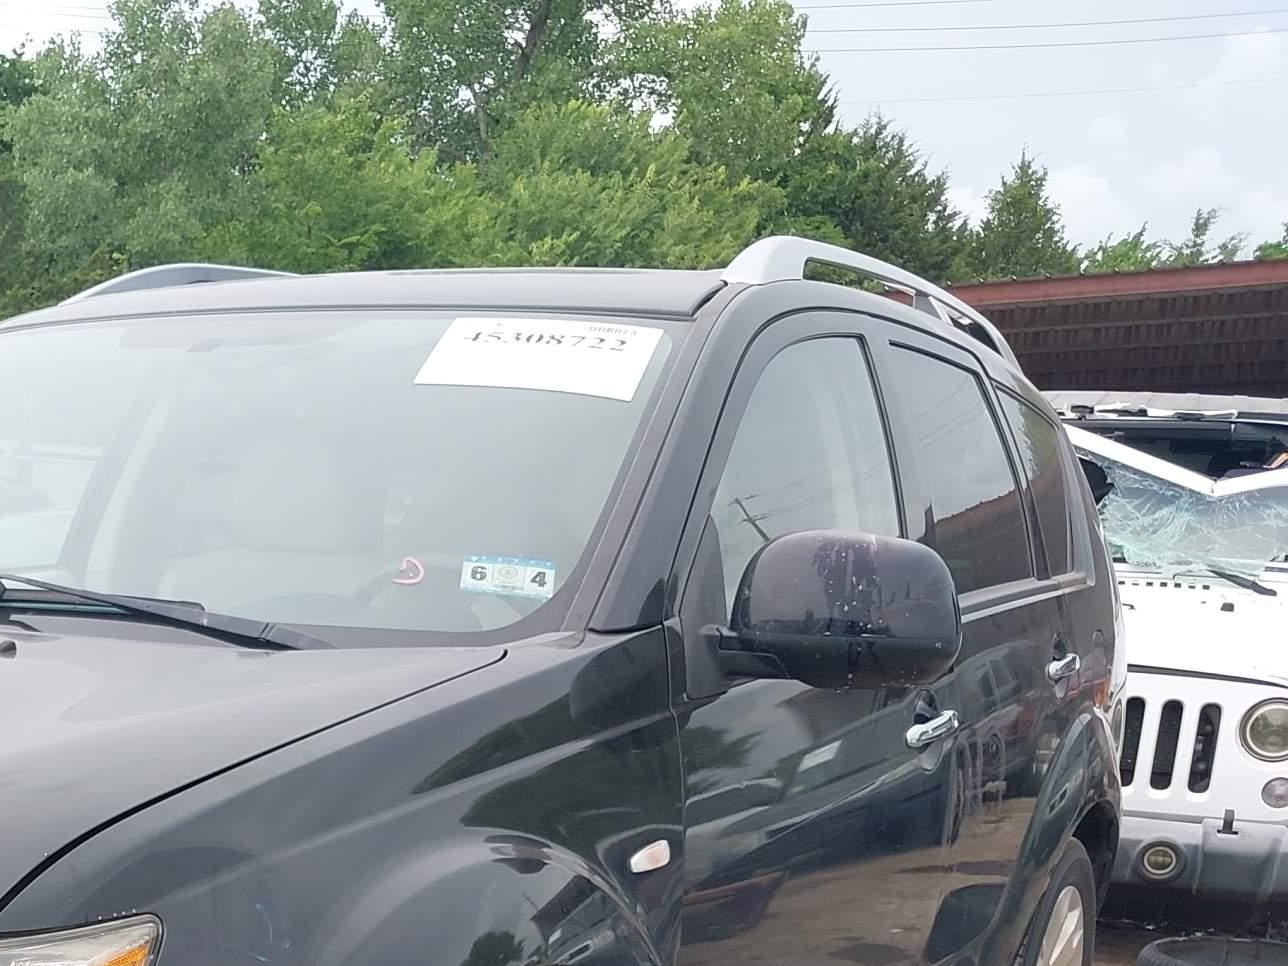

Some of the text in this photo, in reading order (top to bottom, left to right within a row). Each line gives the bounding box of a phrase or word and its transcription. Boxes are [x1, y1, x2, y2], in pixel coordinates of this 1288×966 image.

[463, 331, 627, 351] 45308722
[471, 565, 547, 588] 6 4
